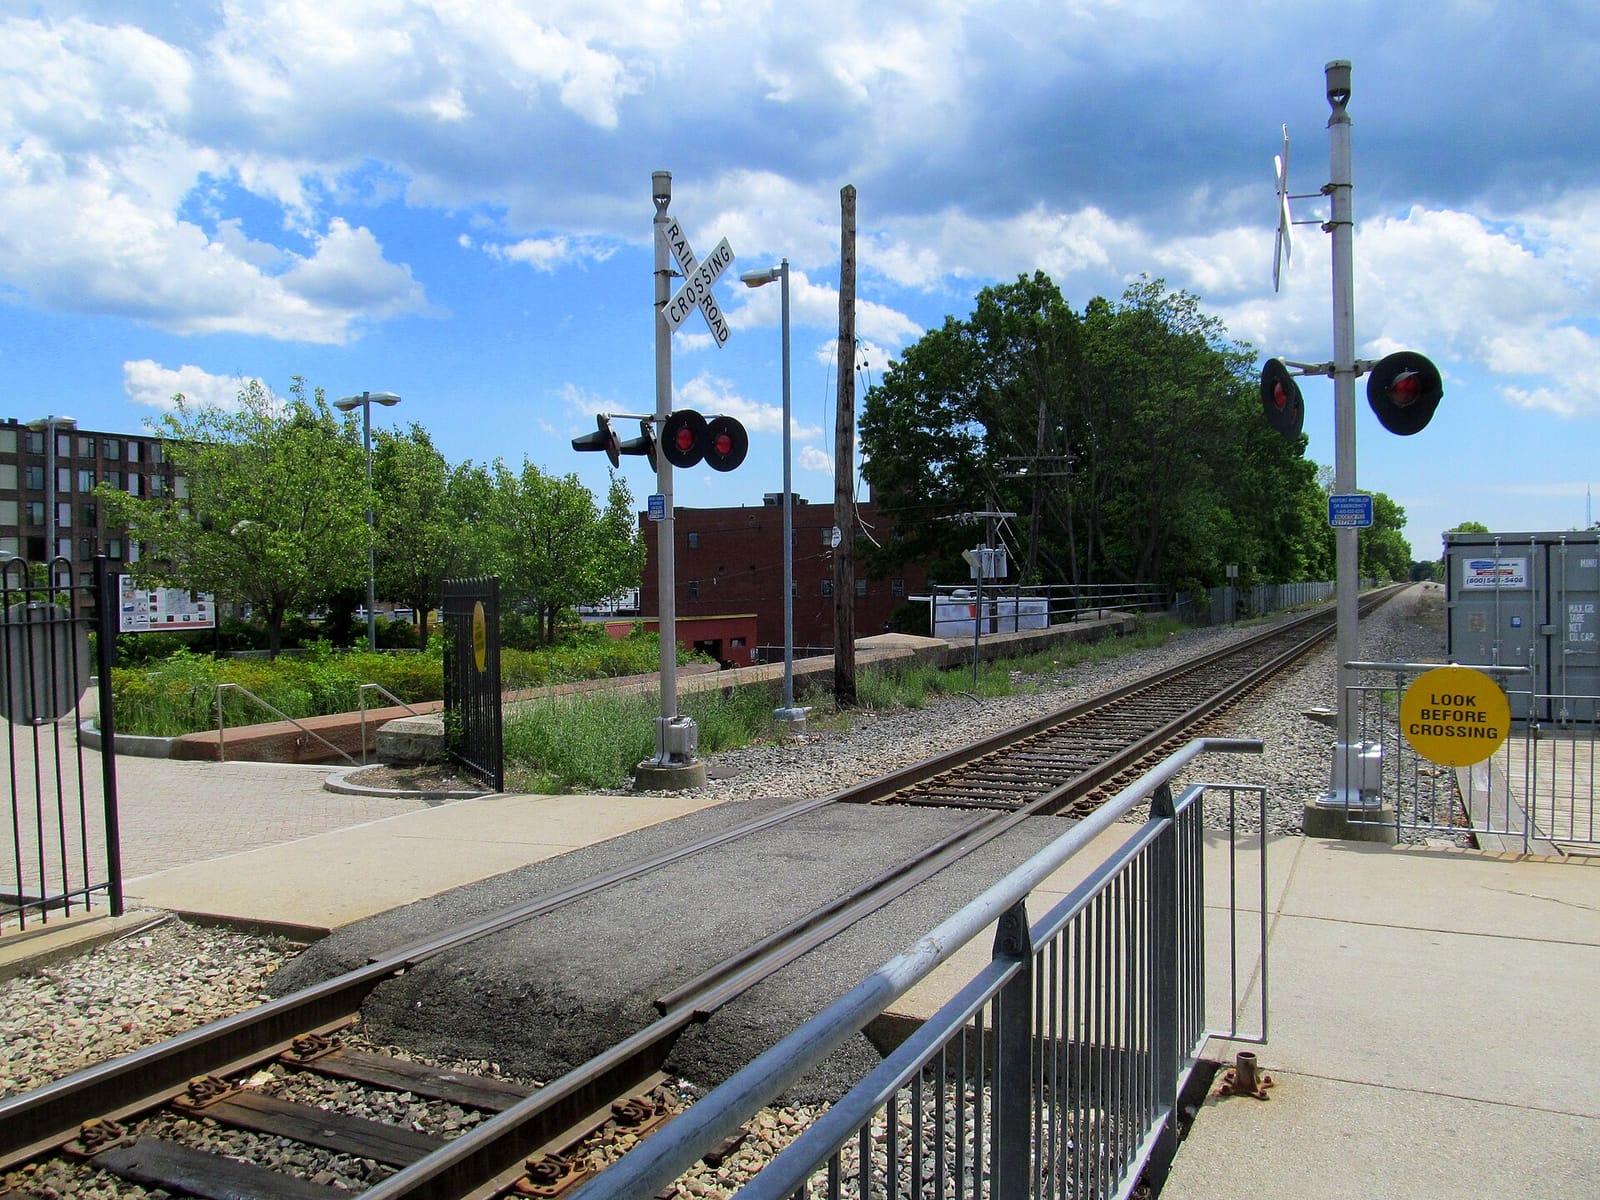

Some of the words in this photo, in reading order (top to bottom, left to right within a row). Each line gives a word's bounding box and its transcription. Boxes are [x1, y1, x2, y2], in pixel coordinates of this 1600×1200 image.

[668, 223, 693, 274] RAIL
[702, 294, 728, 342] ROAD
[670, 246, 730, 323] CROSSING
[1569, 614, 1585, 623] TARE
[1568, 623, 1582, 632] NET
[1431, 694, 1477, 707] LOOK
[1421, 709, 1487, 723] BEFORE
[1410, 723, 1498, 739] CROSSING
